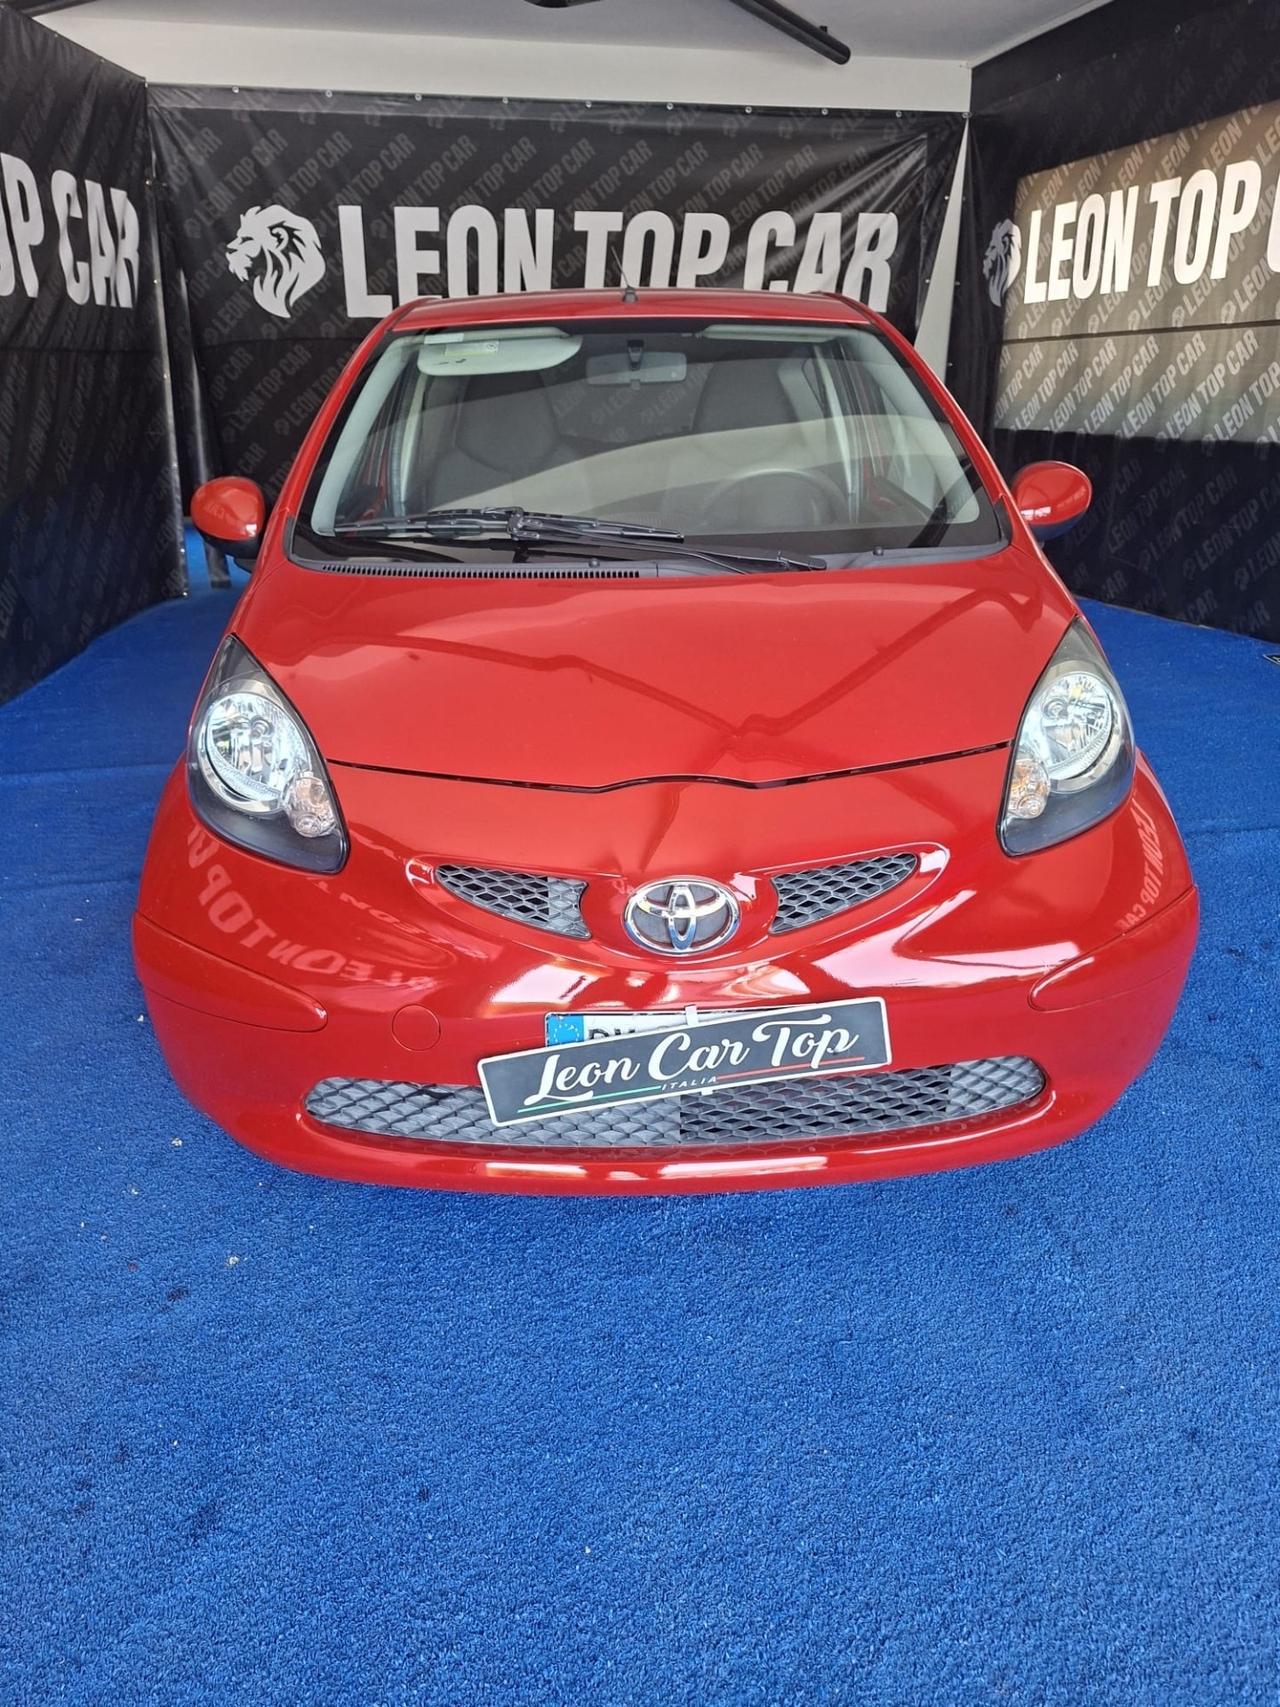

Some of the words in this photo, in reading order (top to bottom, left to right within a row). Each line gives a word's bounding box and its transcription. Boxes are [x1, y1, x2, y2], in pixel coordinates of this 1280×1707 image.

[224, 156, 258, 193] TOP
[289, 157, 321, 195] TOP
[316, 129, 353, 169] CAR
[352, 159, 384, 196] TOP
[379, 131, 416, 171] CAR
[413, 160, 445, 198] TOP
[441, 133, 478, 172] CAR
[474, 162, 506, 198] TOP
[502, 136, 537, 173] CAR
[532, 163, 565, 199] TOP
[561, 137, 596, 175] CAR
[591, 165, 622, 201] TOP
[619, 139, 653, 176] CAR
[646, 166, 677, 201] TOP
[675, 141, 709, 177] CAR
[702, 168, 733, 202] TOP
[731, 143, 764, 179] CAR
[757, 169, 787, 203] TOP
[784, 144, 818, 180] CAR
[51, 170, 139, 308] CAR
[338, 204, 554, 317] LEON
[573, 209, 730, 290] TOP
[744, 210, 898, 313] CAR
[1024, 185, 1139, 304] LEON
[1147, 160, 1262, 288] TOP
[254, 367, 285, 400] TOP
[279, 343, 313, 377] CAR
[1006, 368, 1023, 403] TOP
[1022, 342, 1045, 380] CAR
[1015, 392, 1041, 430] LEON
[1037, 367, 1057, 403] TOP
[1056, 340, 1080, 379] CAR
[1049, 392, 1077, 432] LEON
[1072, 366, 1094, 403] TOP
[1092, 338, 1118, 378] CAR
[1084, 392, 1115, 433] LEON
[1110, 365, 1132, 403] TOP
[1131, 334, 1160, 377] CAR
[1121, 392, 1157, 437] LEON
[1152, 363, 1177, 404] TOP
[1176, 331, 1207, 376] CAR
[1165, 392, 1203, 439] LEON
[1196, 362, 1227, 406] TOP
[1225, 328, 1260, 376] CAR
[1213, 392, 1256, 441] LEON
[523, 1053, 641, 1107] Leon
[647, 1031, 751, 1082] Car
[752, 1013, 860, 1070] Top
[661, 1076, 717, 1091] ITALIA
